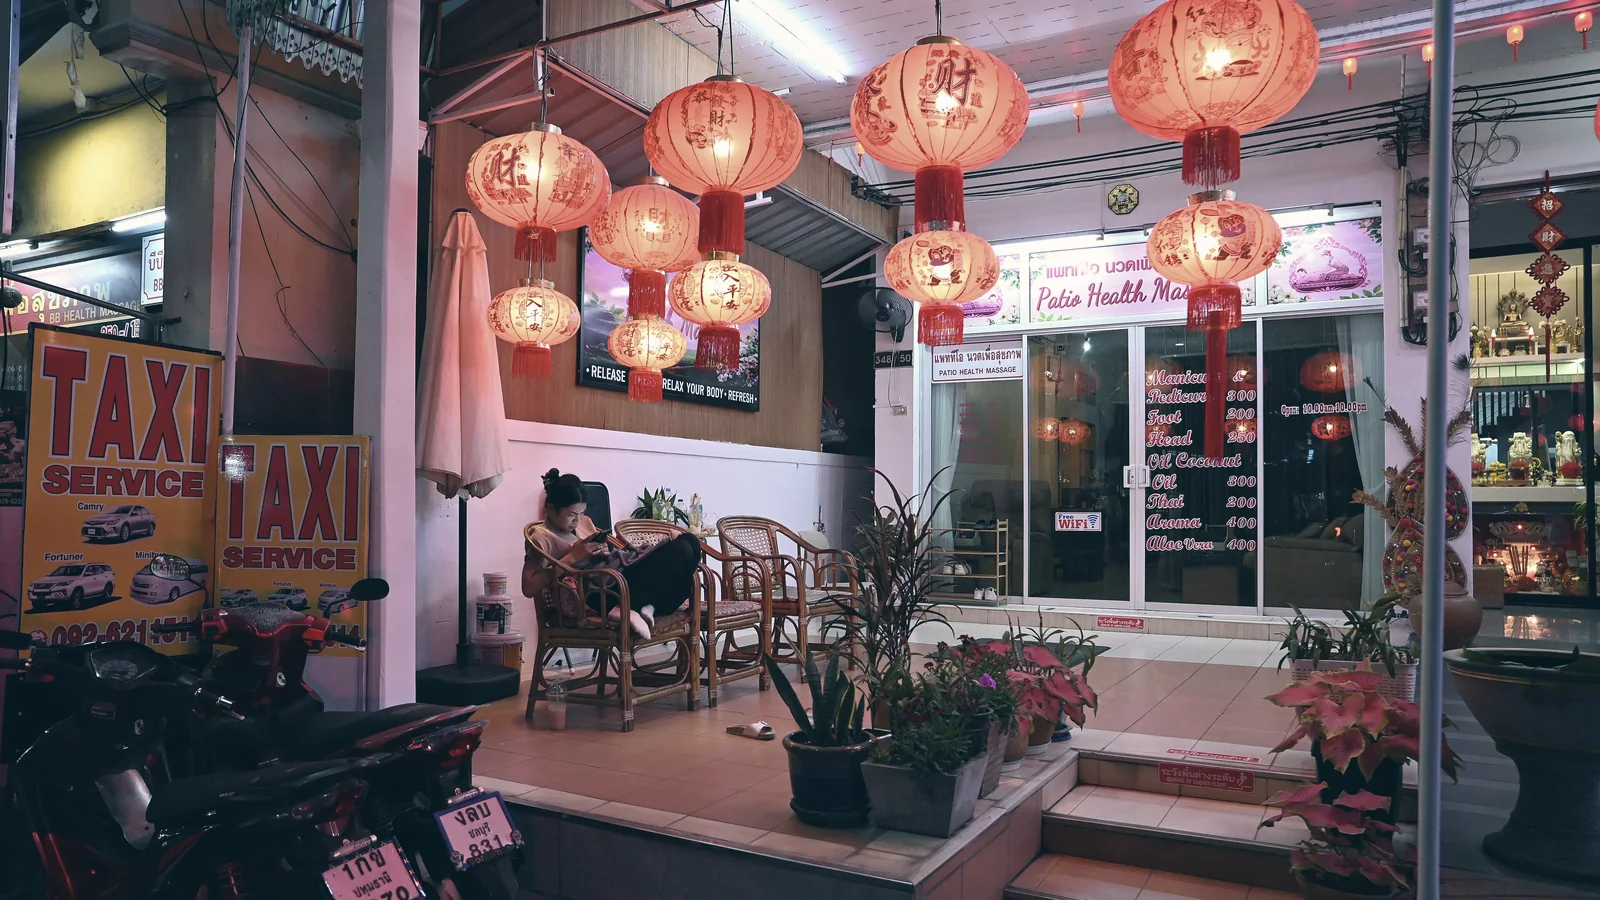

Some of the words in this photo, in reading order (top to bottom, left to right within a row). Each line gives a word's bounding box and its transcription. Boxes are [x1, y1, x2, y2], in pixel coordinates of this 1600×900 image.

[1036, 286, 1081, 311] Patio
[1087, 279, 1147, 308] Health
[1151, 277, 1190, 303] Mas
[50, 313, 60, 324] BB
[64, 307, 97, 322] HEALTH
[591, 365, 626, 383] RELEASE
[939, 369, 958, 377] PATIO
[986, 366, 1017, 374] MASSAGE
[1146, 370, 1206, 386] Manicu
[662, 378, 684, 393] RELAX
[686, 382, 704, 396] YOUR
[706, 385, 724, 399] BODY
[728, 389, 754, 404] REFRESH
[1146, 388, 1207, 404] Pedicur
[1226, 390, 1256, 401] 300
[42, 344, 211, 464] TAXI
[1281, 405, 1299, 417] Open:
[1146, 409, 1182, 425] Foot
[1226, 408, 1255, 419] 200
[1146, 430, 1192, 447] Head
[1227, 431, 1255, 443] 250
[1148, 453, 1172, 471] Oil
[1176, 452, 1241, 468] Coconut
[42, 464, 204, 498] SERVICE
[1152, 473, 1177, 490] Oil
[1227, 475, 1256, 487] 300
[222, 444, 360, 541] TAXI
[1146, 493, 1184, 509] Thai
[1226, 496, 1256, 508] 200
[77, 502, 104, 512] Camry
[1058, 519, 1088, 529] WiFi
[1146, 513, 1202, 530] Aroma
[1226, 516, 1256, 529] 400
[1146, 535, 1183, 551] Aloe
[1184, 538, 1214, 550] Vera
[1226, 539, 1256, 551] 400
[44, 553, 84, 561] Fortuner
[135, 552, 167, 560] Minib
[222, 546, 356, 569] SERVICE
[454, 802, 491, 826] งลบ
[467, 822, 492, 839] ชลบุรี
[468, 834, 502, 858] 831
[352, 870, 393, 898] ปทุมธานี
